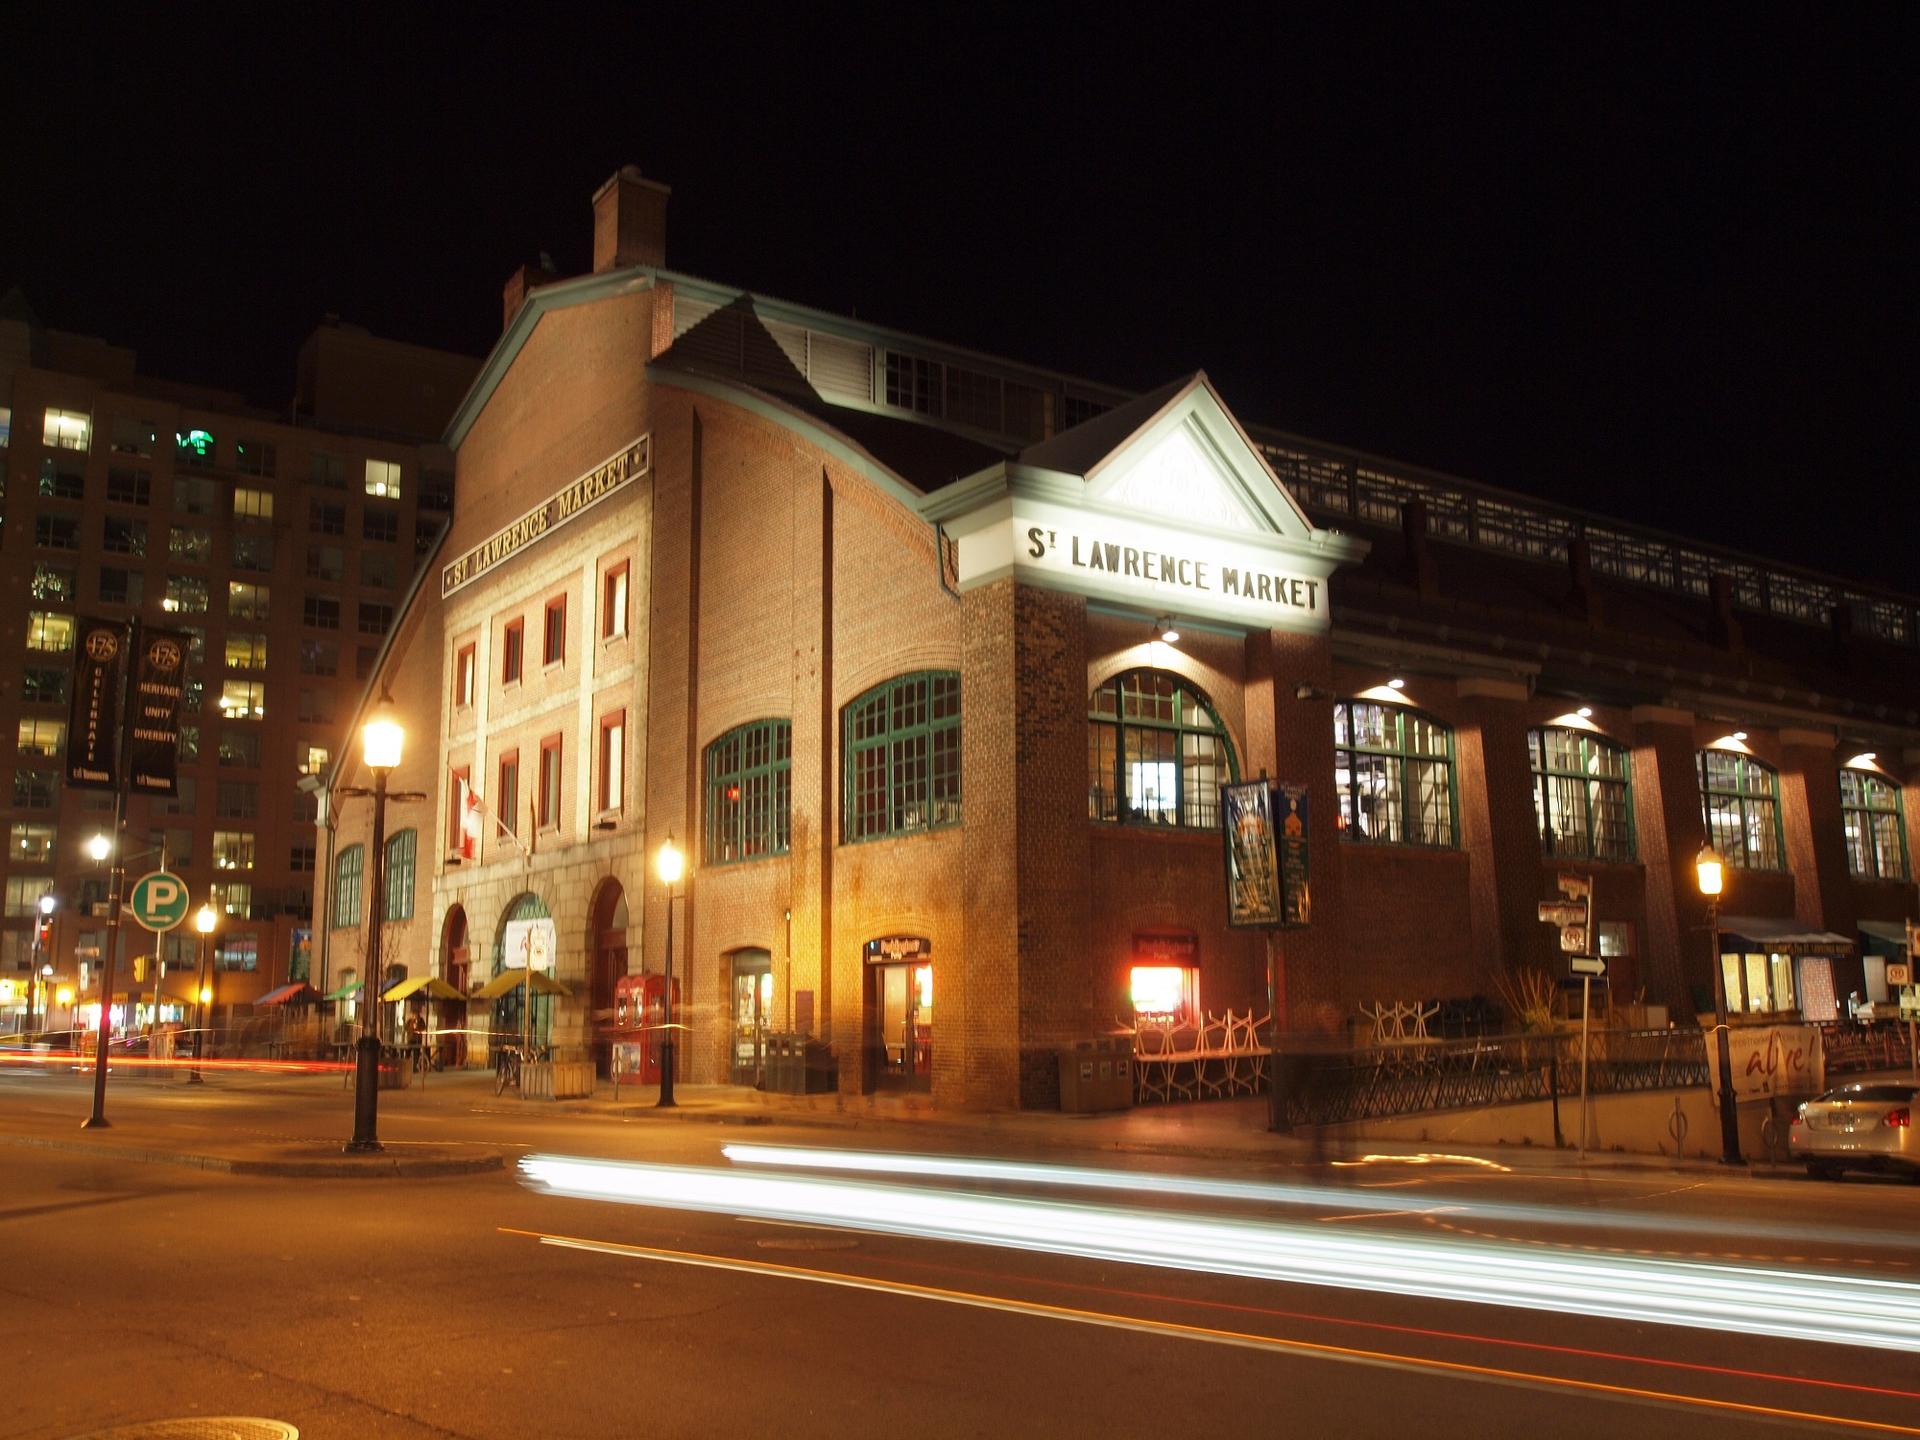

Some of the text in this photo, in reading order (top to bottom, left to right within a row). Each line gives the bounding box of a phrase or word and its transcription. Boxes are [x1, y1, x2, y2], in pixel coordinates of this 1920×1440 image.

[453, 452, 630, 586] ST LAWRENCE MARKET
[1072, 535, 1210, 591] LAWRENCE
[1221, 566, 1320, 611] MARKET
[90, 635, 114, 658] 175
[153, 647, 180, 667] 175
[138, 681, 181, 697] HERITAGE
[144, 705, 171, 719] UNITY
[133, 727, 176, 743] DIVERSITY
[146, 880, 178, 914] P
